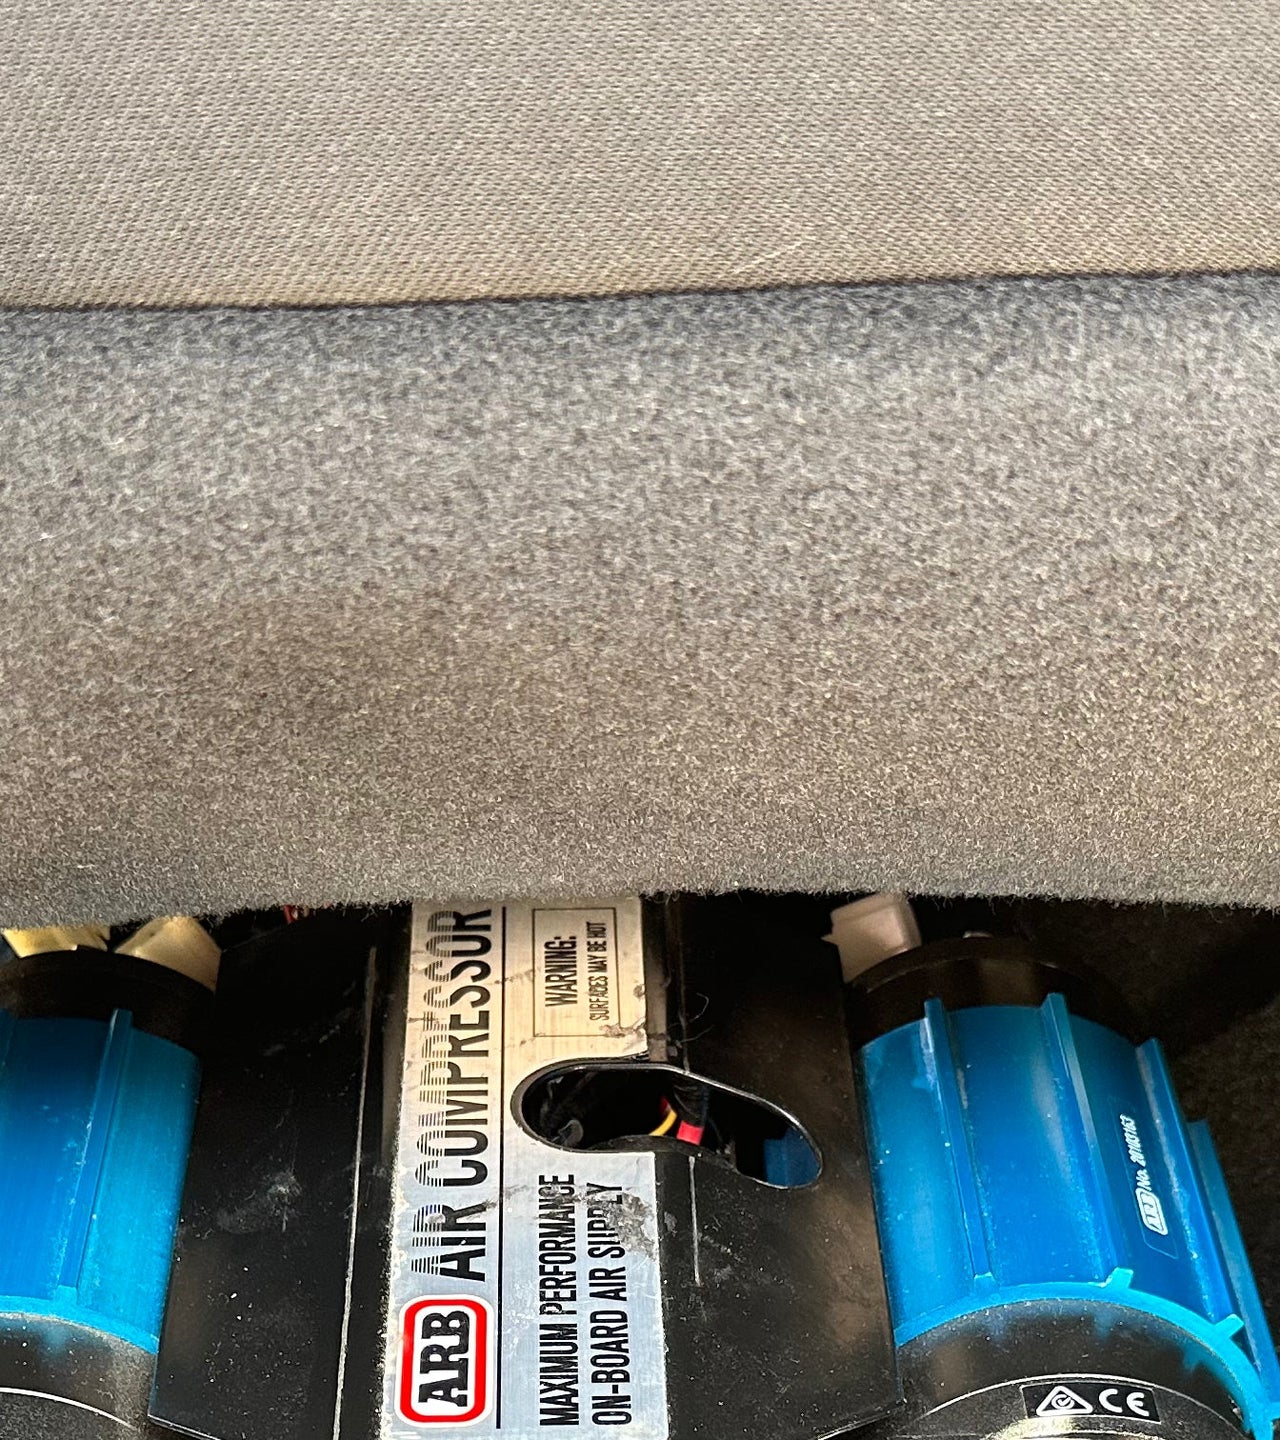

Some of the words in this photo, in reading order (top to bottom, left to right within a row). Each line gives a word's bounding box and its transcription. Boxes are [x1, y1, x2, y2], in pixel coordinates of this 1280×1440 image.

[586, 921, 607, 937] HOT
[587, 939, 607, 952] BE
[587, 954, 608, 973] MAY
[544, 936, 578, 1008] WARNING:
[588, 975, 610, 1021] SURFACES
[415, 908, 492, 1187] COMPRESSOR
[411, 1201, 487, 1283] AIR
[538, 1173, 578, 1316] PERFORMANCE
[587, 1266, 628, 1302] AIR
[418, 1311, 470, 1408] ARB
[539, 1322, 580, 1426] MAXIMUM
[589, 1309, 632, 1426] ON-BOARD
[1098, 1388, 1150, 1417] CE
